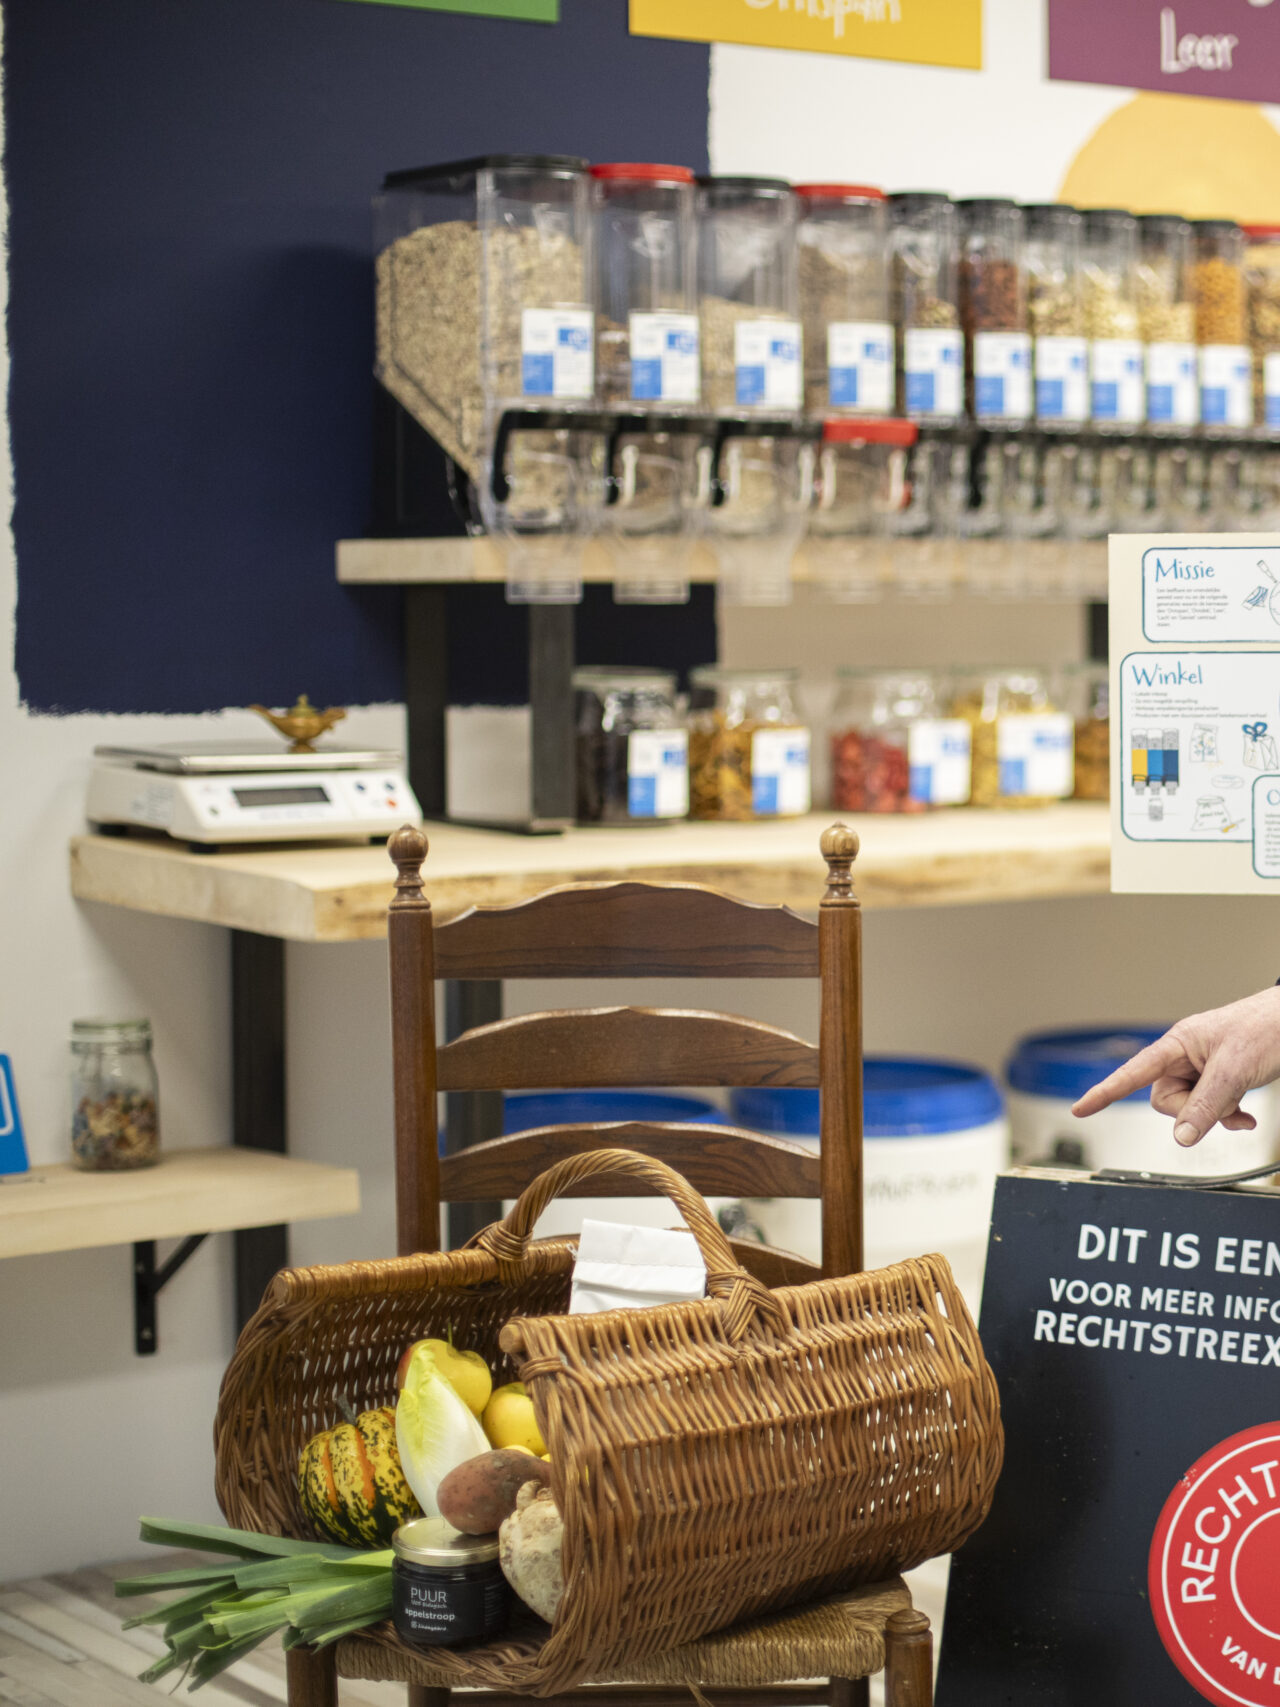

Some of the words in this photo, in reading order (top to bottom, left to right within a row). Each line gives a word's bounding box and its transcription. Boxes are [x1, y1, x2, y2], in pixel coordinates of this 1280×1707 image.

[1161, 8, 1239, 73] Leer
[1155, 557, 1215, 582] Missie
[1132, 661, 1203, 687] Winkel
[1077, 1224, 1148, 1264] DIT
[1159, 1231, 1200, 1269] IS
[1049, 1277, 1132, 1309] VOOR
[1140, 1286, 1214, 1317] MEER
[410, 1586, 447, 1603] PUUR
[404, 1607, 456, 1622] appelstroop
[1219, 1635, 1268, 1680] VAN
